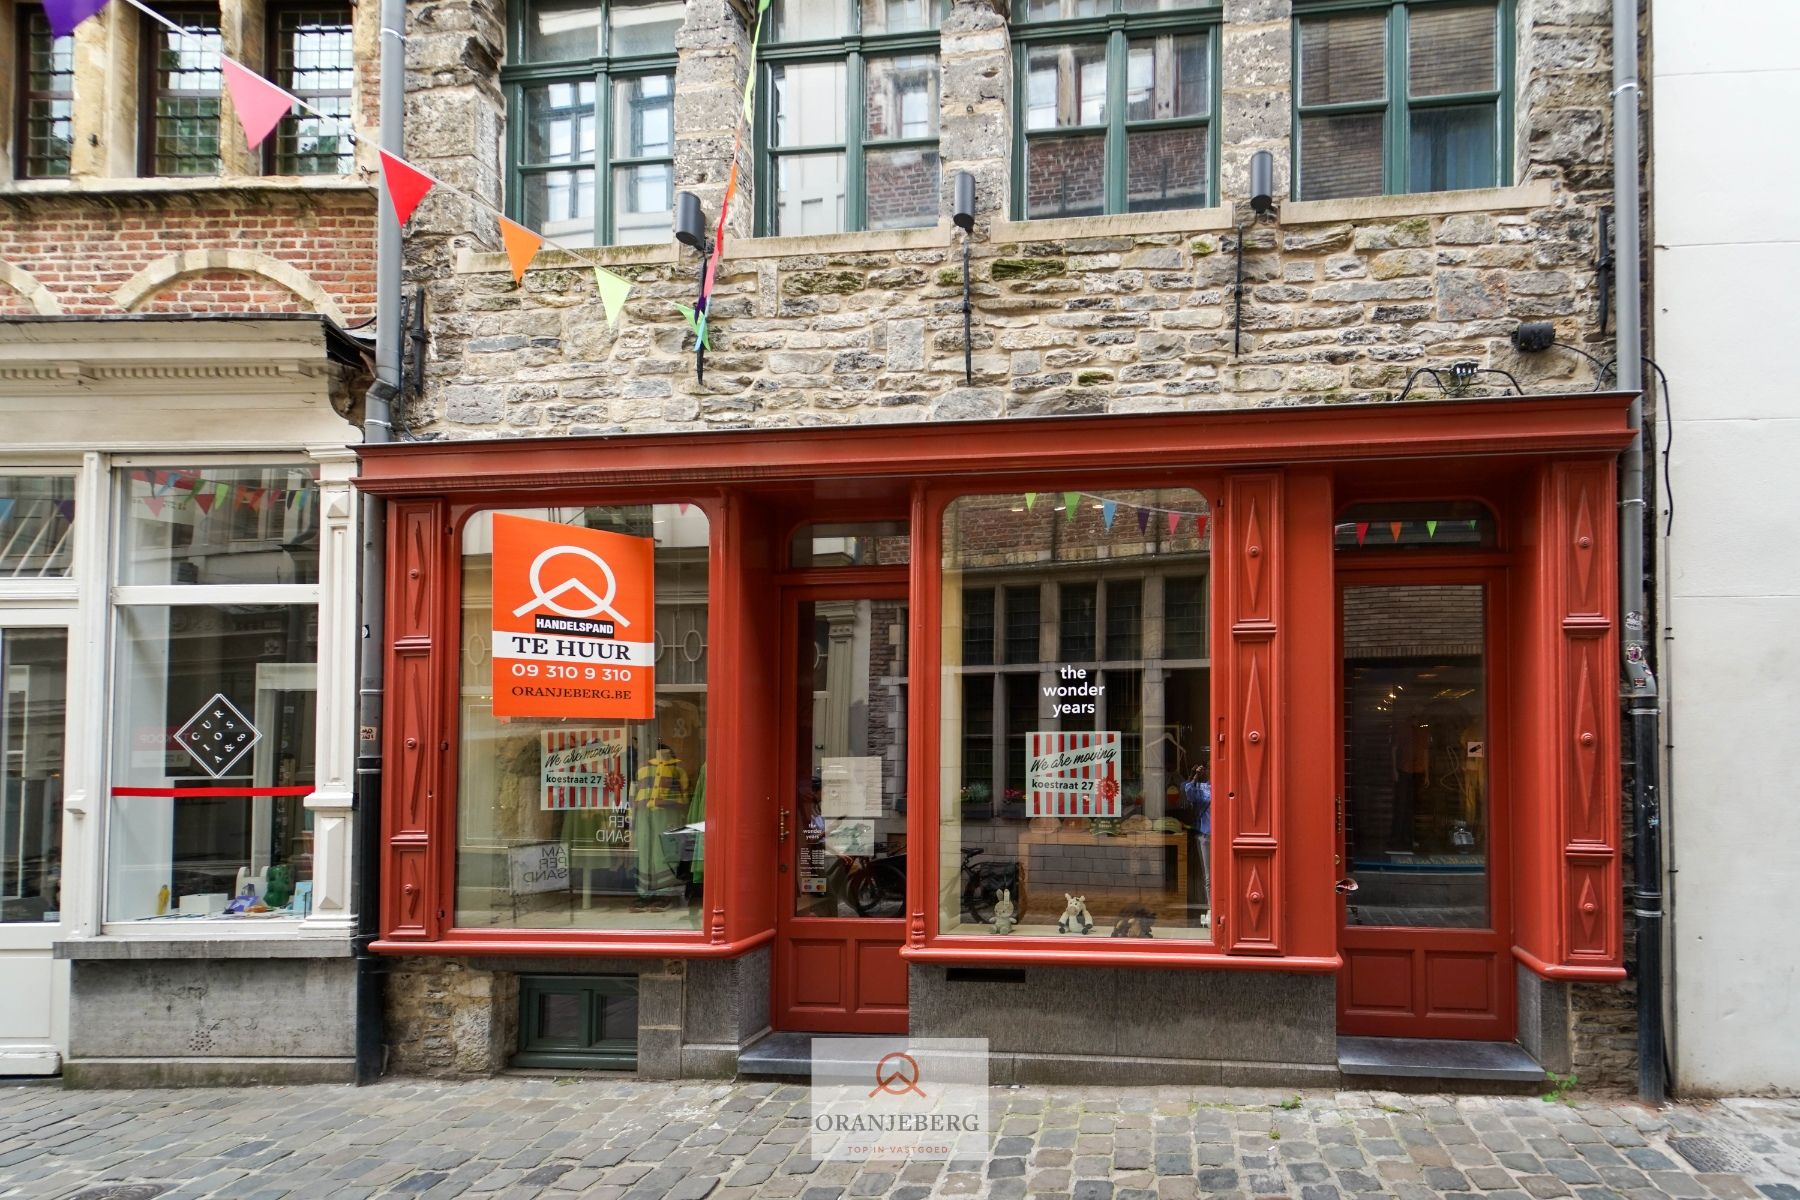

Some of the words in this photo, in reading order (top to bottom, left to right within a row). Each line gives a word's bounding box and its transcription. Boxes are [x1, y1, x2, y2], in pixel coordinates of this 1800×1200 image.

[536, 618, 614, 634] HANDELSPAND
[512, 636, 549, 655] TE
[556, 639, 631, 660] HUUR
[511, 663, 539, 677] 09
[546, 665, 578, 679] 310
[584, 667, 596, 680] 9
[602, 668, 632, 682] 310
[1060, 664, 1087, 679] the
[511, 686, 632, 700] ORANJEBERG.BE
[1043, 681, 1105, 696] wonder
[1052, 703, 1095, 718] years
[545, 753, 561, 768] We
[563, 750, 582, 764] are
[583, 744, 623, 759] moving
[1030, 758, 1048, 772] We
[1051, 753, 1072, 769] are
[1073, 748, 1117, 764] moving
[546, 774, 588, 784] koestraat
[590, 776, 602, 784] 27
[1032, 779, 1078, 790] koestraat
[1081, 781, 1094, 790] 27
